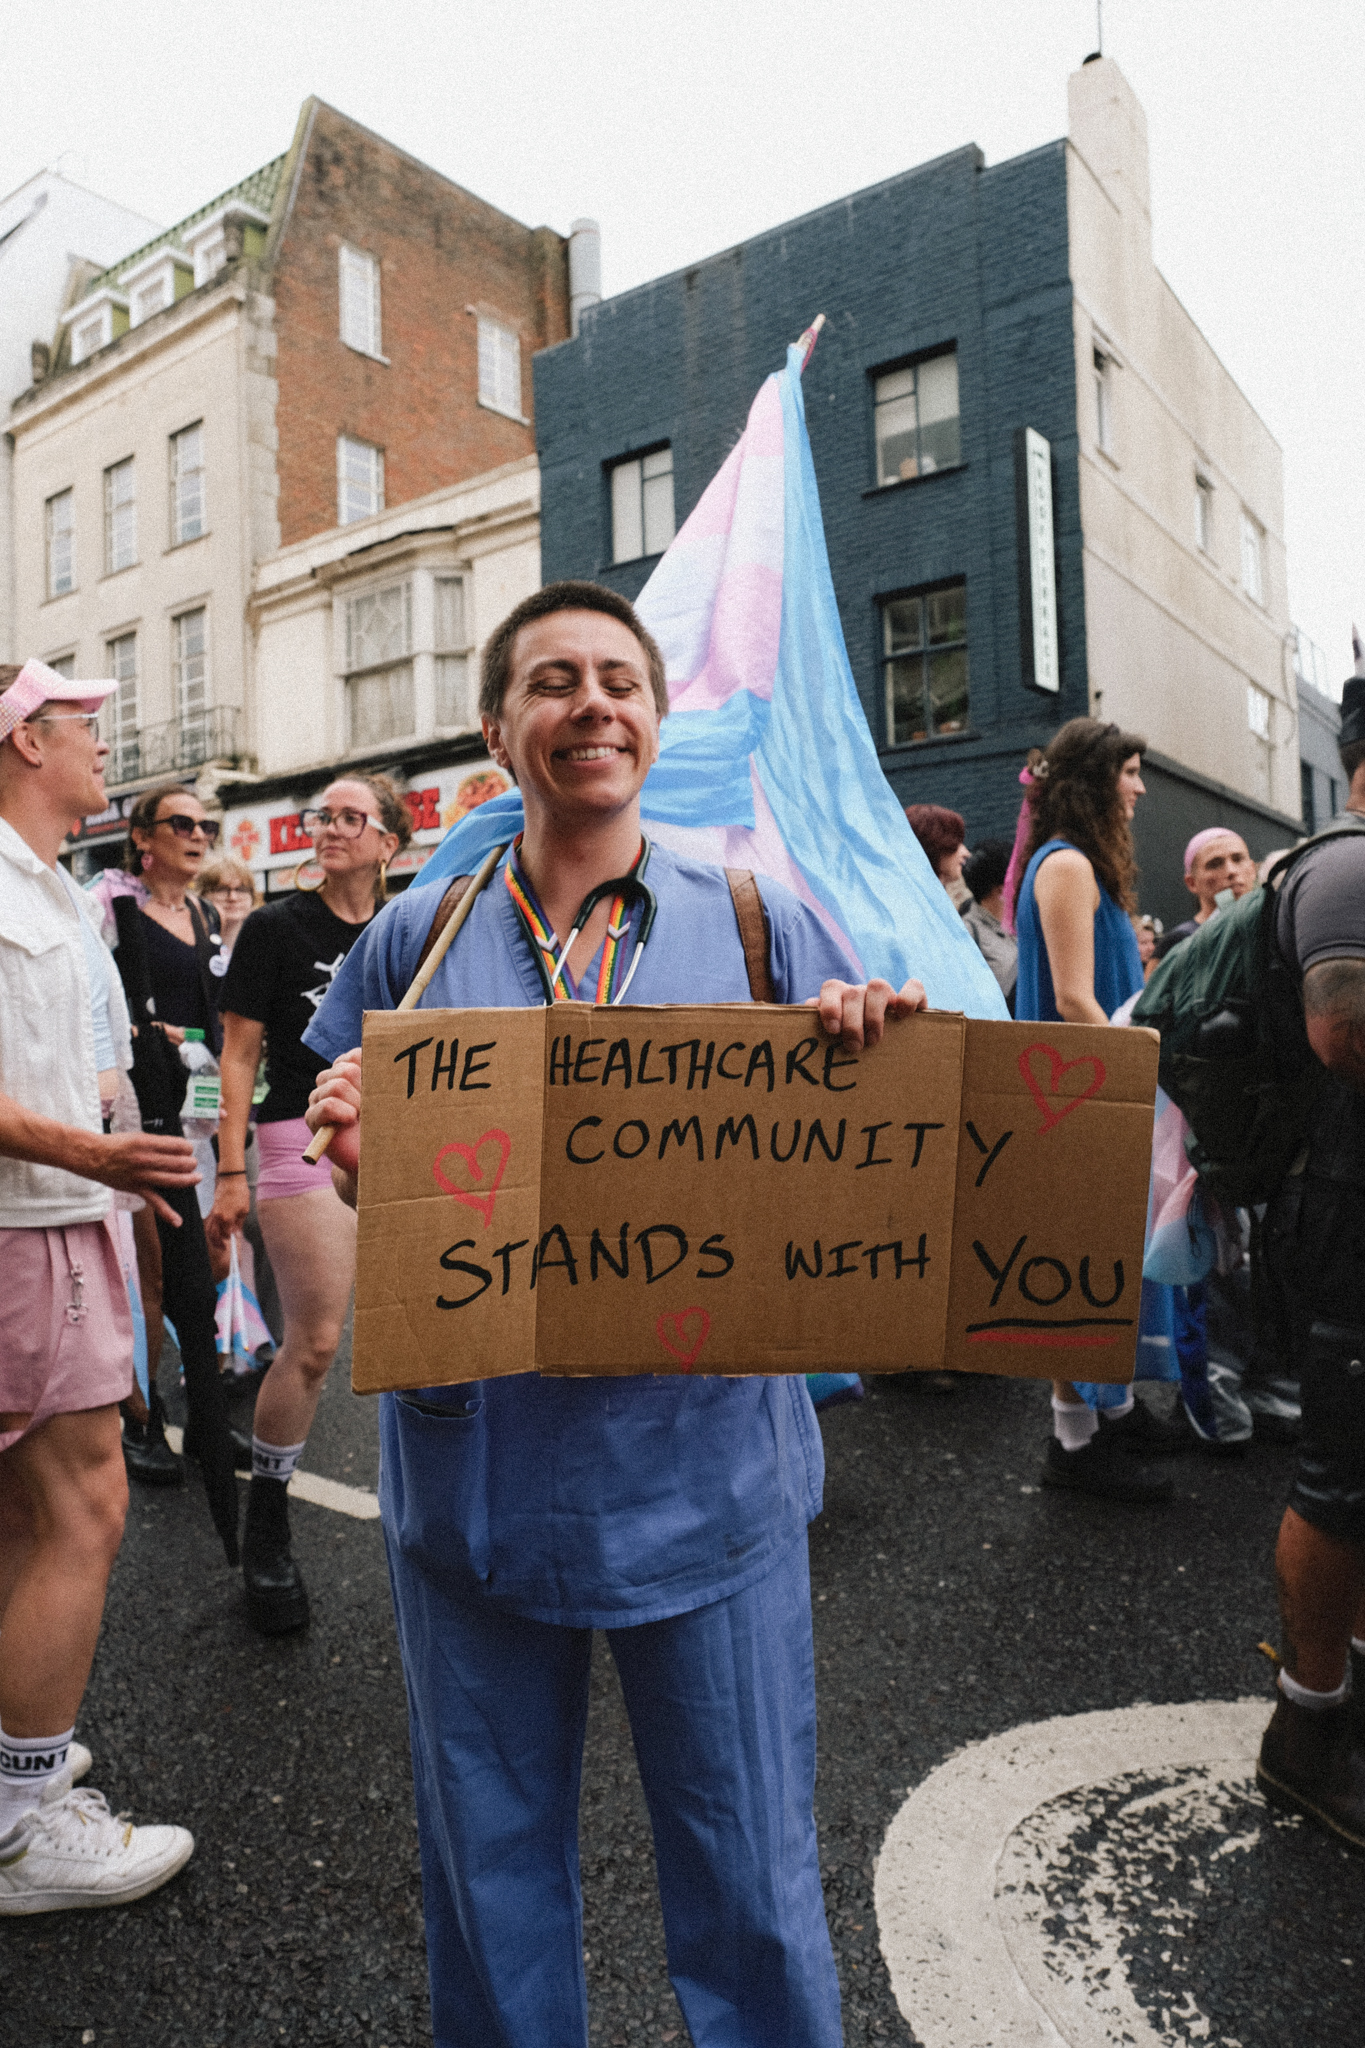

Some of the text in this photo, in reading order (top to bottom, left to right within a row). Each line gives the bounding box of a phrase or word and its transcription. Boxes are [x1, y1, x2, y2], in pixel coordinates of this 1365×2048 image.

[394, 1034, 859, 1098] THE HEALTHCARE
[565, 1114, 1014, 1188] COMMUNITY
[436, 1222, 1126, 1310] STANDS WITH YOU
